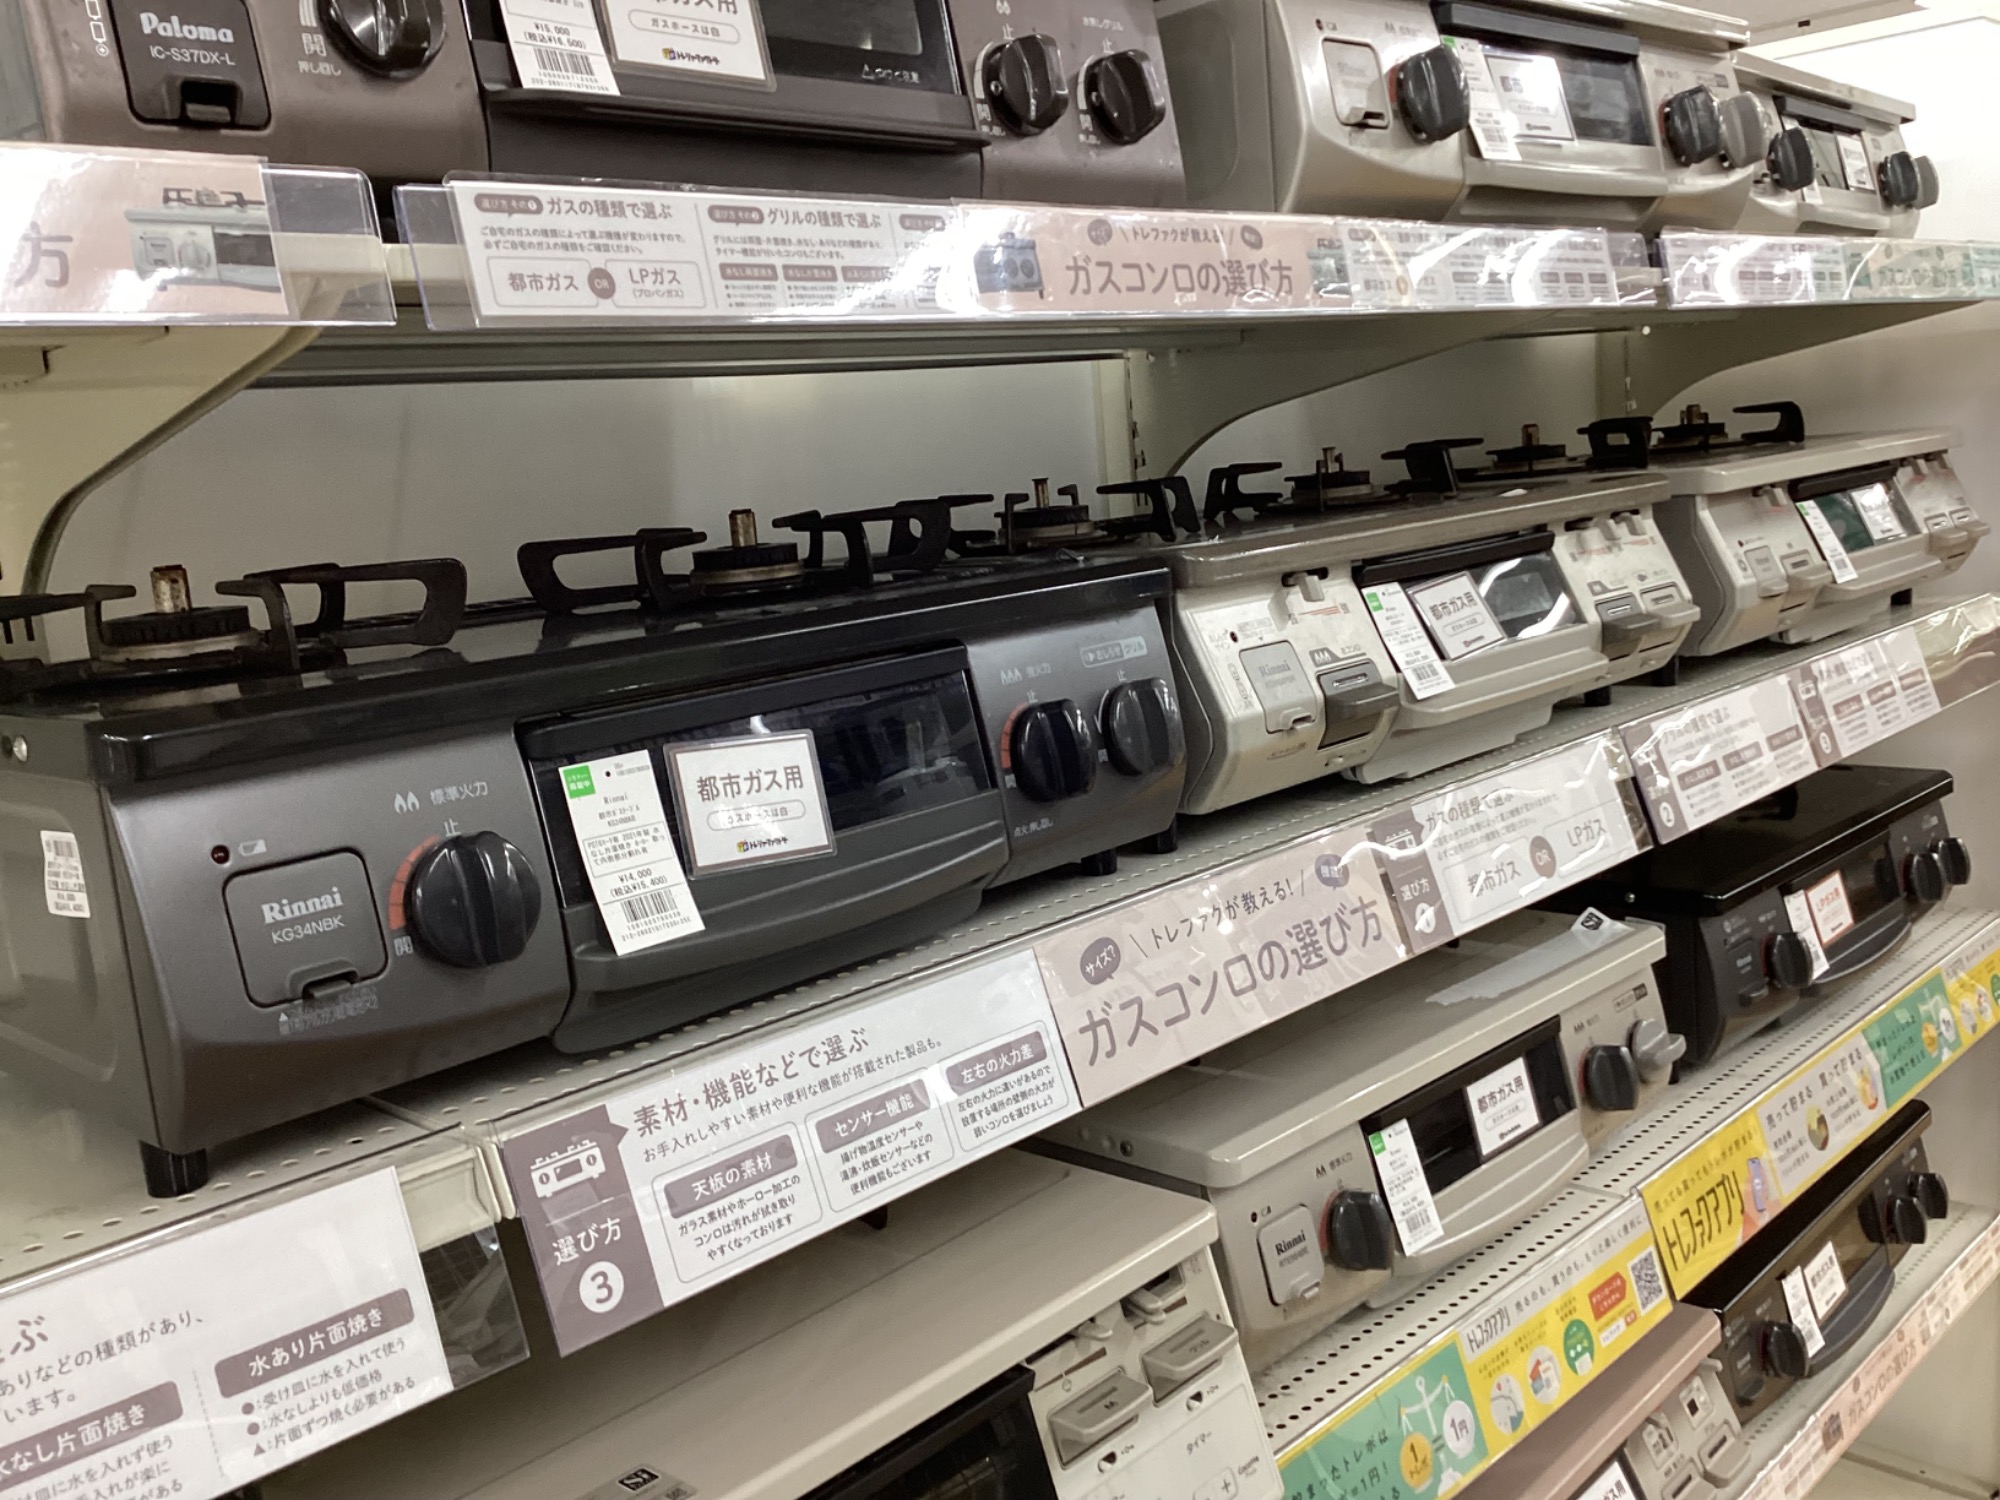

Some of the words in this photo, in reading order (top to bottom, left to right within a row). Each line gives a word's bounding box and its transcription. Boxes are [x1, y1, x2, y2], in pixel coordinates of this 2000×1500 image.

[140, 12, 235, 44] Paloma
[150, 44, 235, 66] IC-S37DX-L
[548, 198, 673, 219] ガスの種類で選ぶ
[767, 208, 882, 229] グリルの種類で選ぶ
[14, 221, 74, 288] 方
[1065, 254, 1293, 298] ガスコンロの選び方
[508, 271, 579, 292] 都市ガス
[595, 279, 609, 289] OR
[629, 268, 681, 286] LPガス
[1430, 591, 1478, 621] 都市ガス用
[429, 780, 489, 806] 標準火力
[697, 765, 804, 803] 都市ガス用
[444, 817, 461, 838] 止
[1566, 818, 1608, 848] LPガス
[618, 868, 652, 884] ¥14,000
[261, 886, 344, 926] Rinnai
[271, 914, 345, 945] KG34NBK
[1078, 895, 1383, 1068] ガスコンロの選び方
[633, 1027, 869, 1138] 素材・機能などで選ぶ
[960, 1043, 1035, 1085] 左右の火力差
[643, 1036, 942, 1163] お手入れしやすい素材や便利な機能が搭載された製品も。
[957, 1065, 1051, 1113] 左右の火力に違いがあるので
[1478, 1074, 1525, 1115] 都市ガス用
[1765, 1085, 1814, 1130] 売って貯まる
[834, 1093, 915, 1138] センサー機能
[973, 1095, 1054, 1139] 弱いコンロを選びましょう
[840, 1120, 924, 1165] 揚げ物温度センサーや
[691, 1151, 773, 1202] 天板の素材
[850, 1151, 932, 1196] 便利機能もございます
[677, 1174, 801, 1238] ガラス素材やホーロー加工の
[694, 1193, 796, 1249] コンロは汚れが拭き取り
[1663, 1170, 1745, 1272] トレファクアプリ
[551, 1217, 622, 1267] 選び方
[706, 1213, 794, 1262] やすくなっております
[1275, 1229, 1306, 1256] Rinnai
[249, 1308, 383, 1377] 水あり片面焼き
[1466, 1306, 1512, 1353] トレファクアプリ
[0, 1310, 204, 1397] ありなどの種類があり、
[4, 1389, 77, 1424] います。
[1449, 1417, 1469, 1442] 1円
